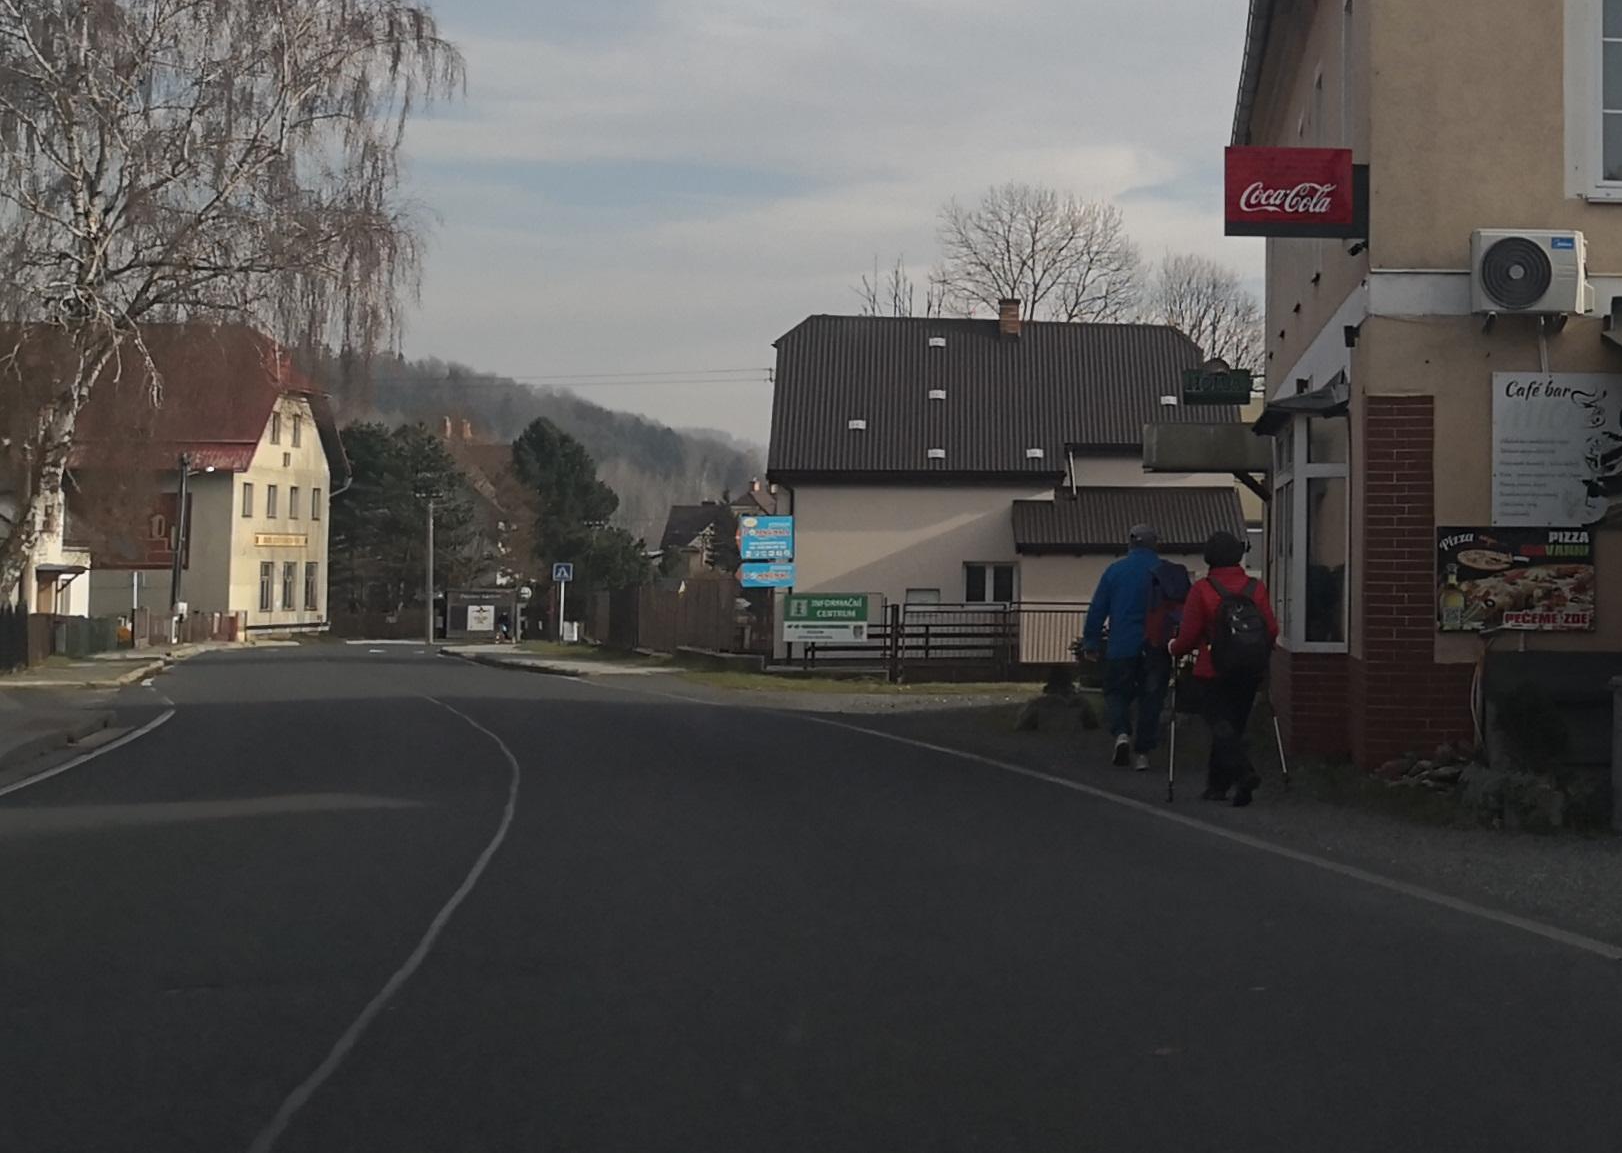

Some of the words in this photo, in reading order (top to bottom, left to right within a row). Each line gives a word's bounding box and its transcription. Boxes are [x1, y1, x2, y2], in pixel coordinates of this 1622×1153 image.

[1239, 182, 1337, 214] Coca-Cola
[1505, 381, 1541, 401] Café
[1545, 381, 1571, 398] bar
[1439, 532, 1475, 552] Pizza
[1548, 531, 1590, 544] PIZZA
[816, 609, 856, 618] CENTRUM
[1504, 611, 1559, 625] PEČEME
[1564, 613, 1587, 625] ZDE
